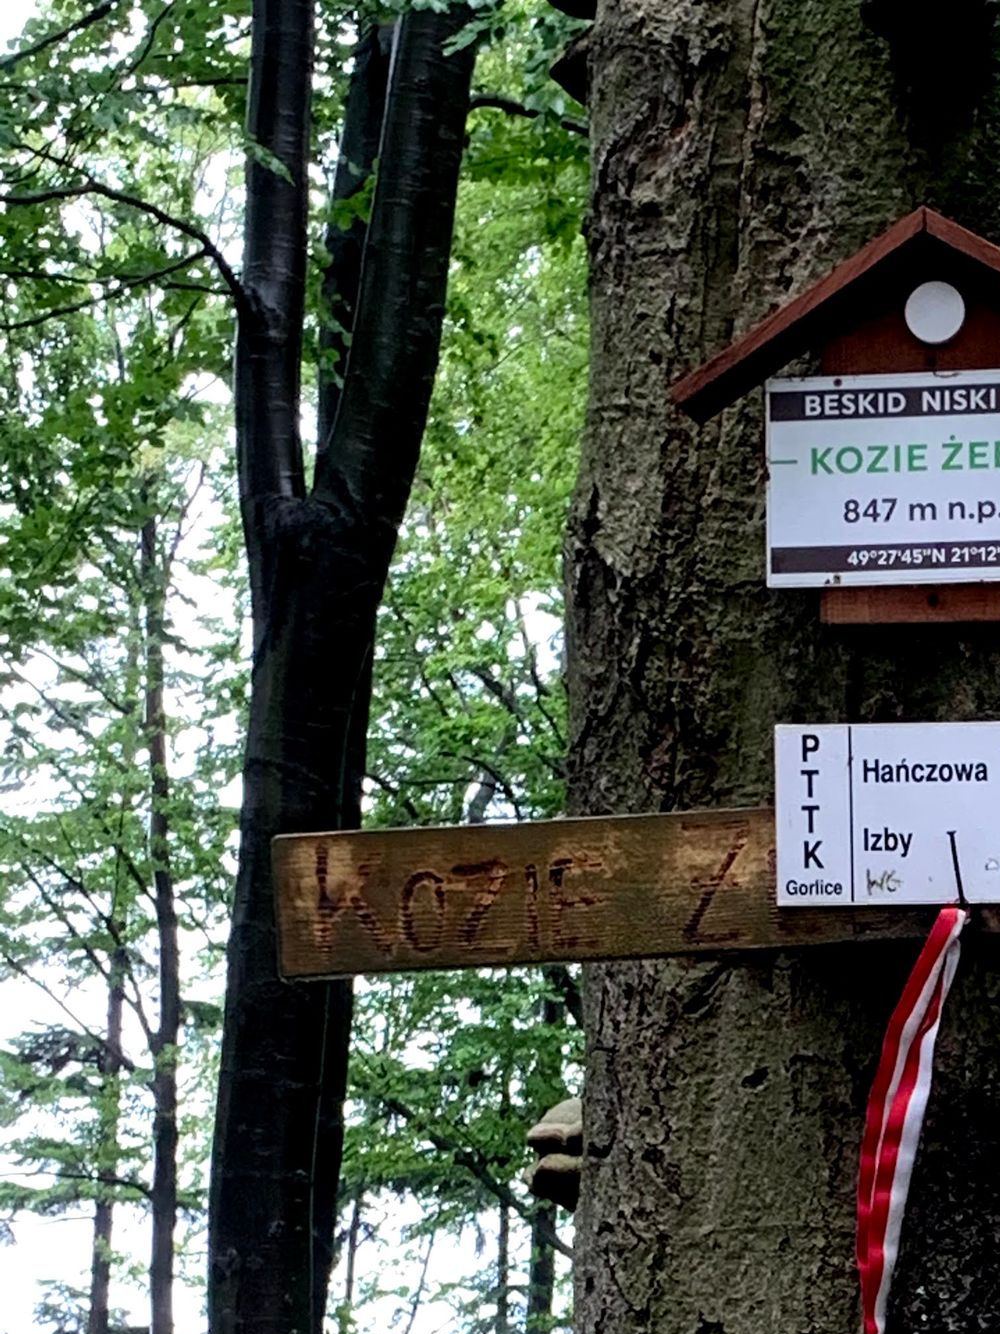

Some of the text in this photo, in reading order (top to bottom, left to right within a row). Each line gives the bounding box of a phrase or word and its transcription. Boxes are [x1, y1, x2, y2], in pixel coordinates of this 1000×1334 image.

[804, 388, 996, 417] BESKID NISKI
[811, 443, 928, 475] KOZIE
[843, 498, 898, 523] 847
[909, 502, 937, 521] m
[862, 758, 988, 783] Hańczowa
[863, 829, 913, 857] Izby
[785, 880, 843, 895] Gorlice
